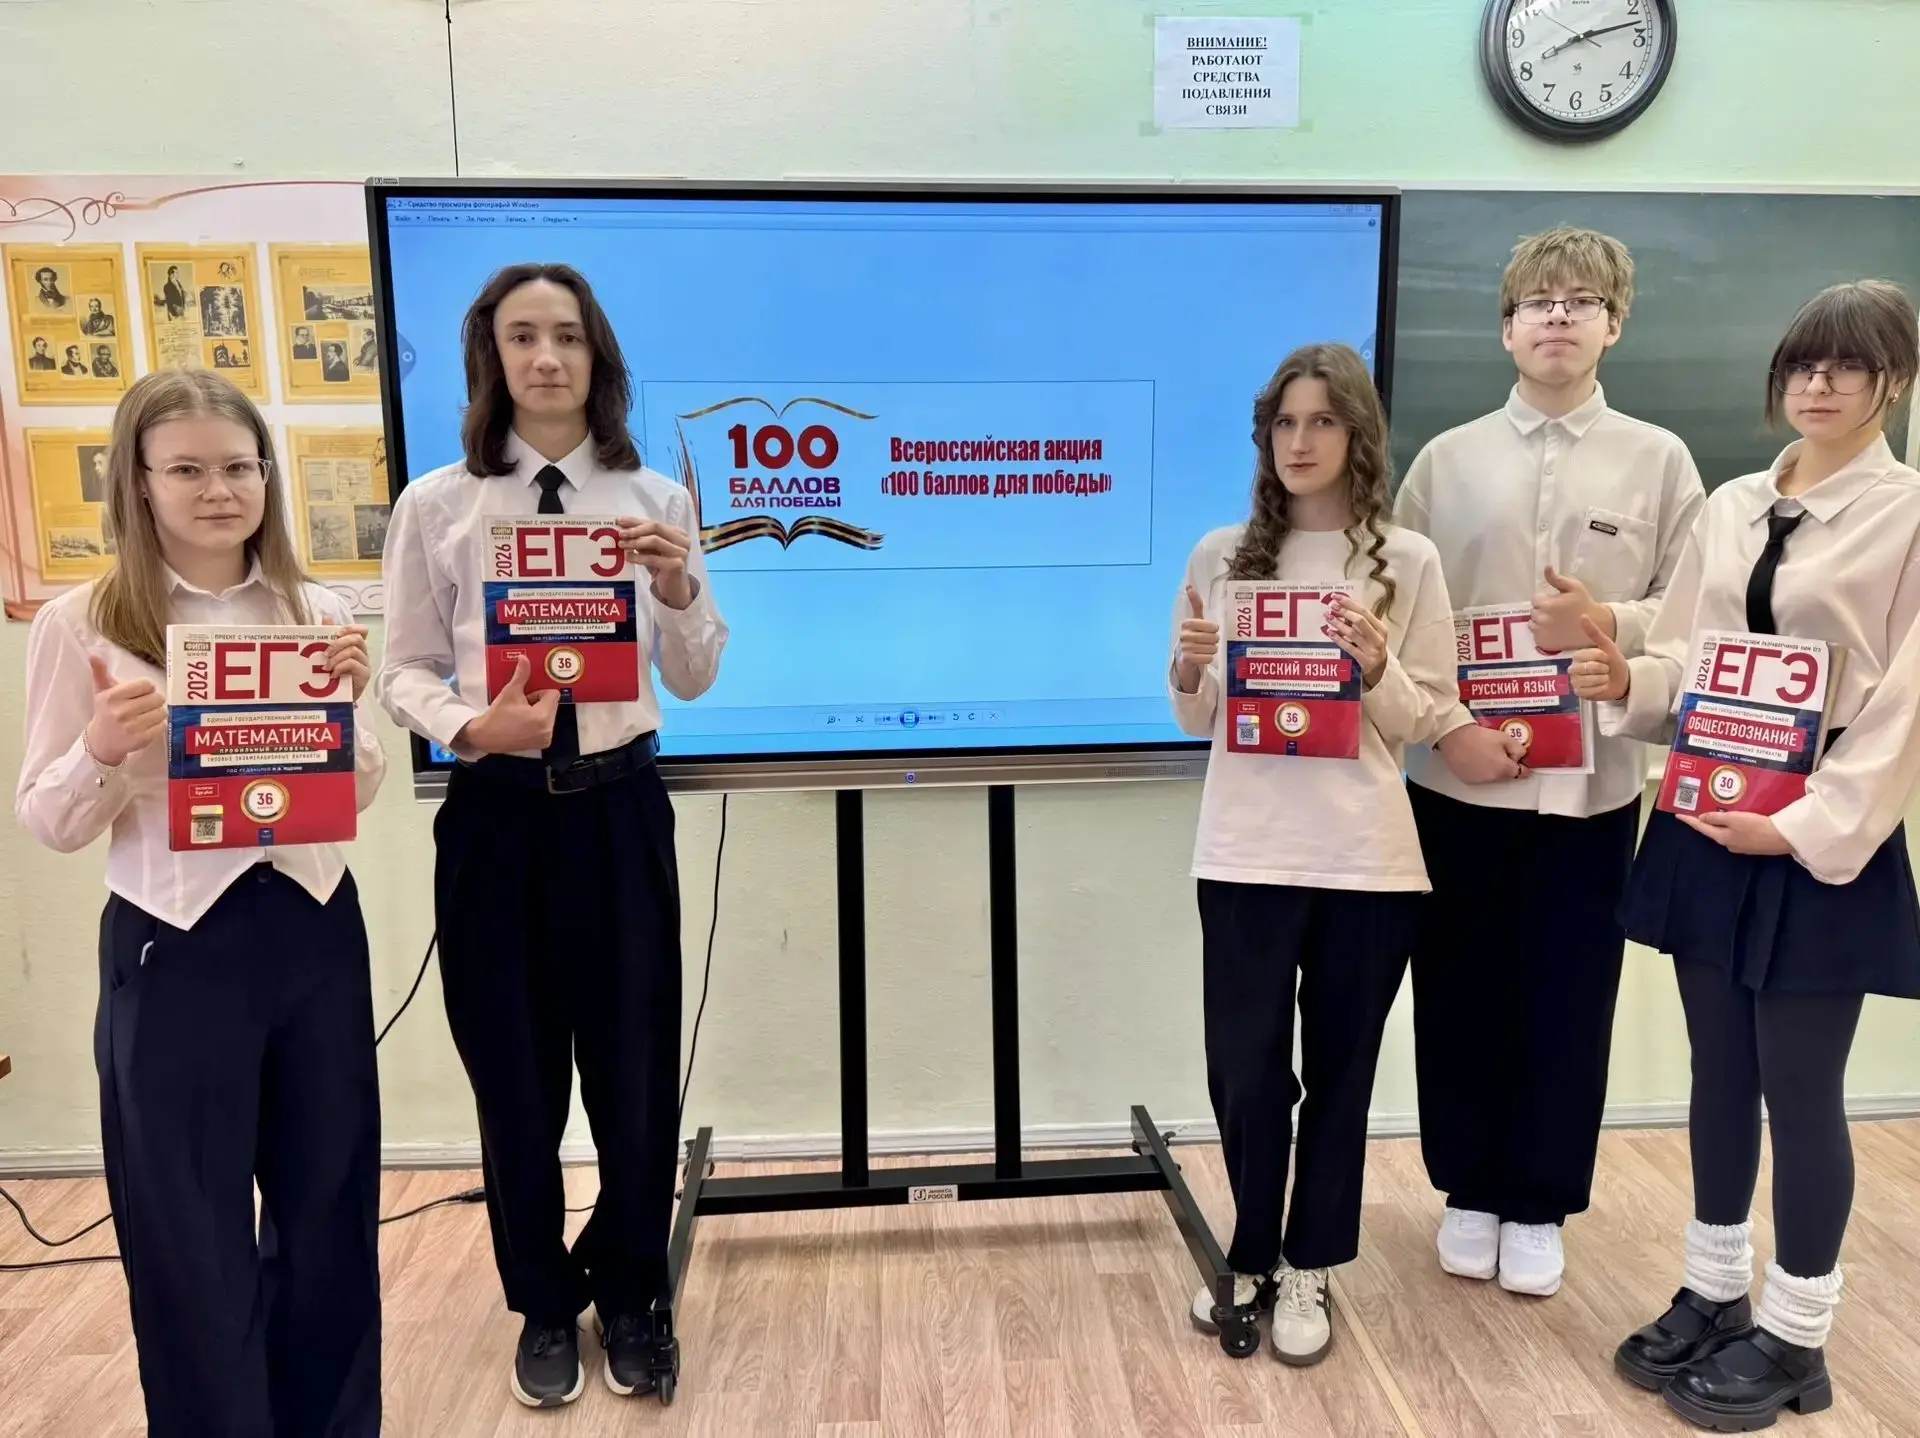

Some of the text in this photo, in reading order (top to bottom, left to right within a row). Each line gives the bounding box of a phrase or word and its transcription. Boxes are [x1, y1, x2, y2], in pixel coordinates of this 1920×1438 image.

[1187, 36, 1267, 48] ВНИМАНИЕ!
[1512, 28, 1525, 48] 9
[1633, 28, 1646, 47] 3
[1192, 55, 1263, 66] РАБОТАЮТ
[1618, 60, 1634, 80] 4
[1193, 71, 1260, 83] СРЕДСТВА
[1519, 61, 1533, 81] 8
[1182, 88, 1271, 100] ПОДАВЛЕНИЯ
[1543, 83, 1556, 102] 7
[1569, 90, 1582, 110] 6
[1599, 83, 1613, 102] 5
[1206, 104, 1247, 115] СВЯЗИ
[728, 424, 839, 469] 100
[890, 434, 1102, 465] Всероссийская акция
[729, 477, 840, 494] БАЛЛОВ
[881, 469, 1112, 498] «100 баллов для победы»
[730, 497, 841, 508] ДЛЯ ПОБЕДЫ
[495, 543, 513, 578] 2026
[516, 527, 625, 577] ЕГЭ
[504, 602, 620, 617] МАТЕМАТИКА
[1237, 606, 1252, 637] 2026
[1456, 633, 1471, 662] 2026
[215, 642, 340, 700] ЕГЭ
[557, 657, 572, 669] 36
[1250, 660, 1338, 676] РУССКИЙ ЯЗЫК
[187, 661, 208, 700] 2026
[1694, 658, 1712, 691] 2026
[1709, 643, 1819, 703] ЕГЭ
[1471, 680, 1556, 696] РУССКИЙ ЯЗЫК
[1286, 712, 1298, 723] 36
[194, 727, 334, 747] МАТЕМАТИКА
[1510, 728, 1522, 738] 36
[1687, 715, 1798, 747] ОБЩЕСТВОЗНАНИЕ
[1719, 776, 1734, 789] 30
[256, 792, 274, 806] 36
